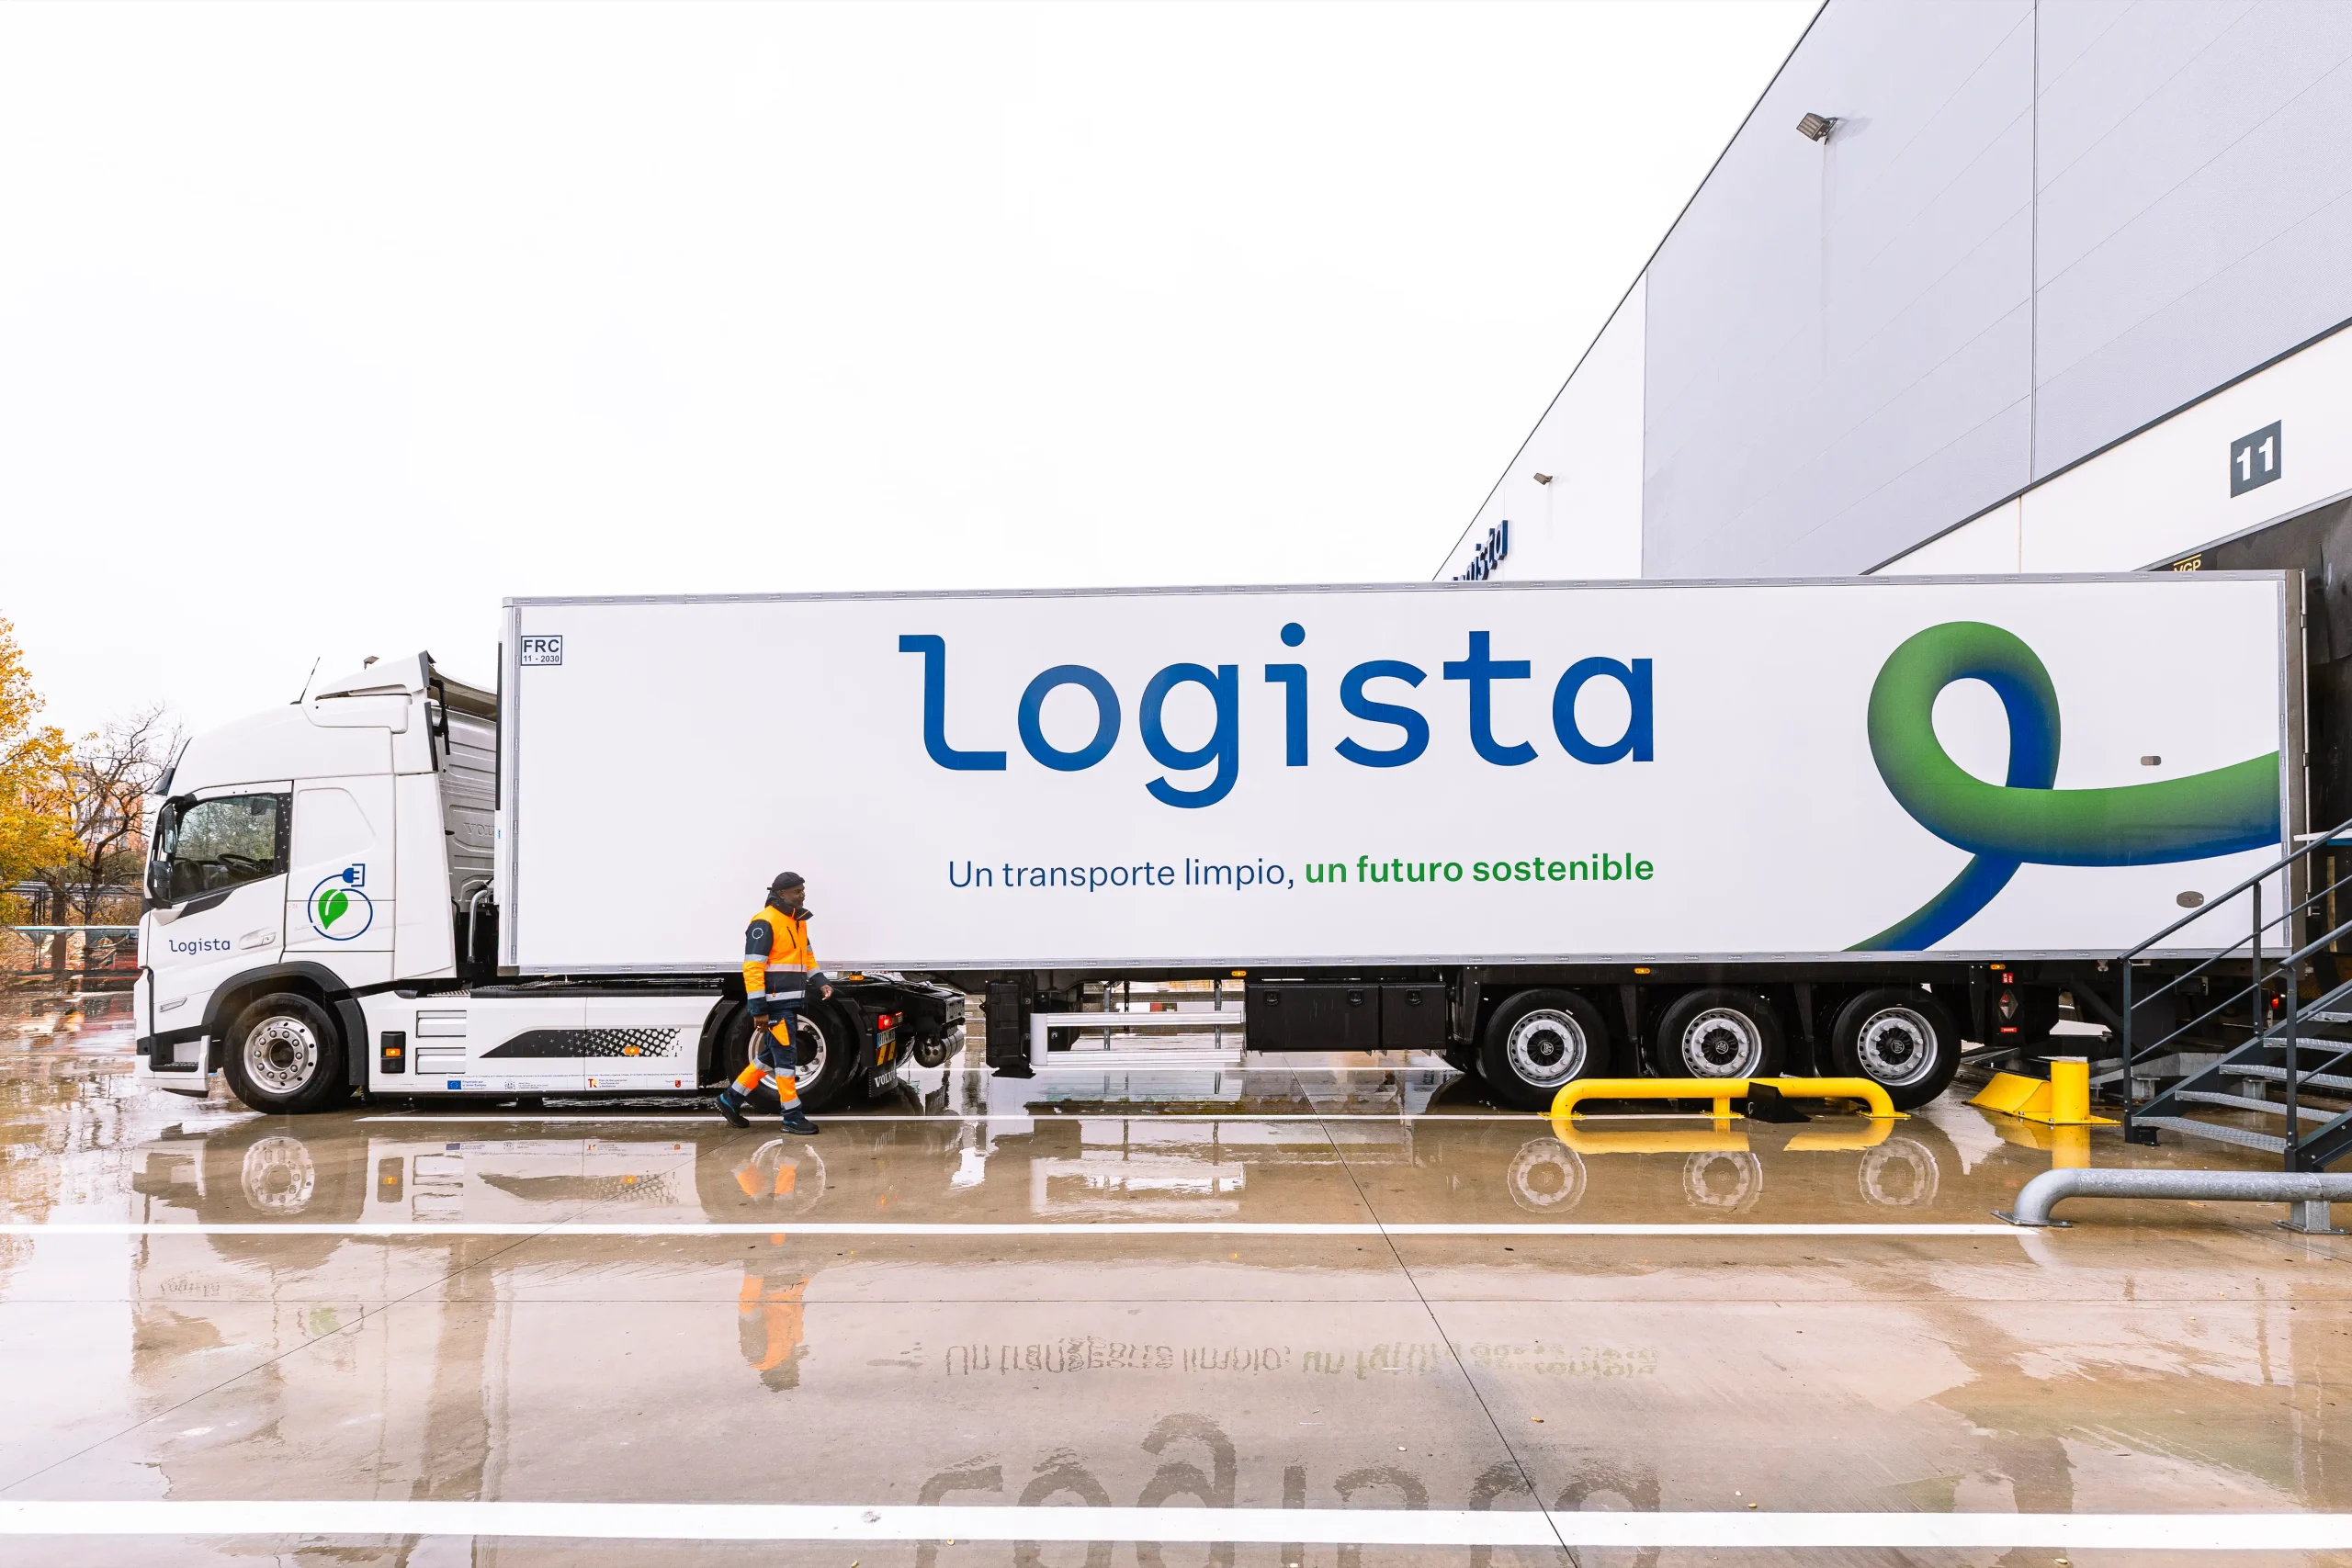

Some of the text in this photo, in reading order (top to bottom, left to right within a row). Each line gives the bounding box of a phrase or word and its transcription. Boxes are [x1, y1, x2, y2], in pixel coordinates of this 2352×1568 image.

[2236, 435, 2274, 481] 11
[524, 638, 560, 653] FRC
[899, 622, 1654, 809] logista
[949, 852, 1654, 893] Un transporte limpio, un futuro sostenible
[168, 938, 231, 955] logista
